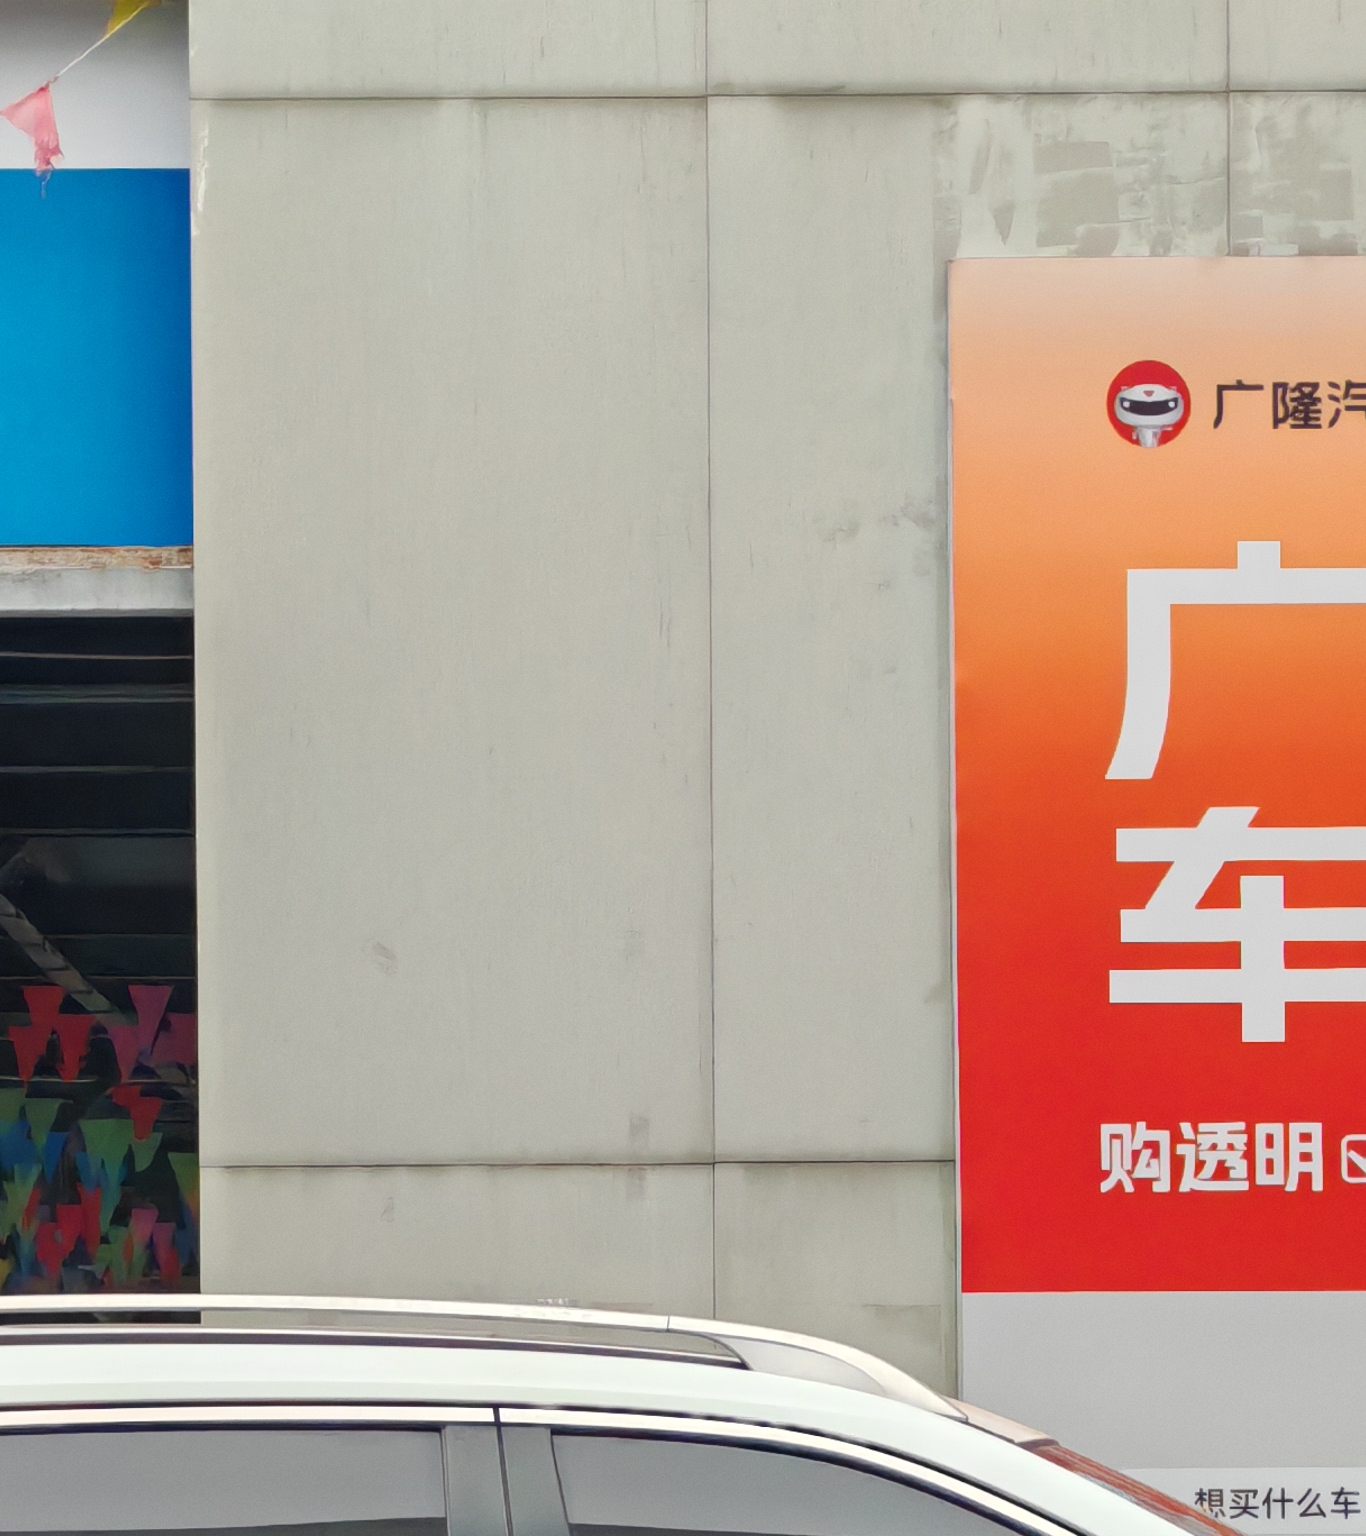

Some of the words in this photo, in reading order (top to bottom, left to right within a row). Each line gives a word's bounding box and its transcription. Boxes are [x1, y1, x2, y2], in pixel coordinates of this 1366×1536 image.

[1100, 1123, 1324, 1194] 购透明
[1194, 1486, 1362, 1520] 想买什么车
